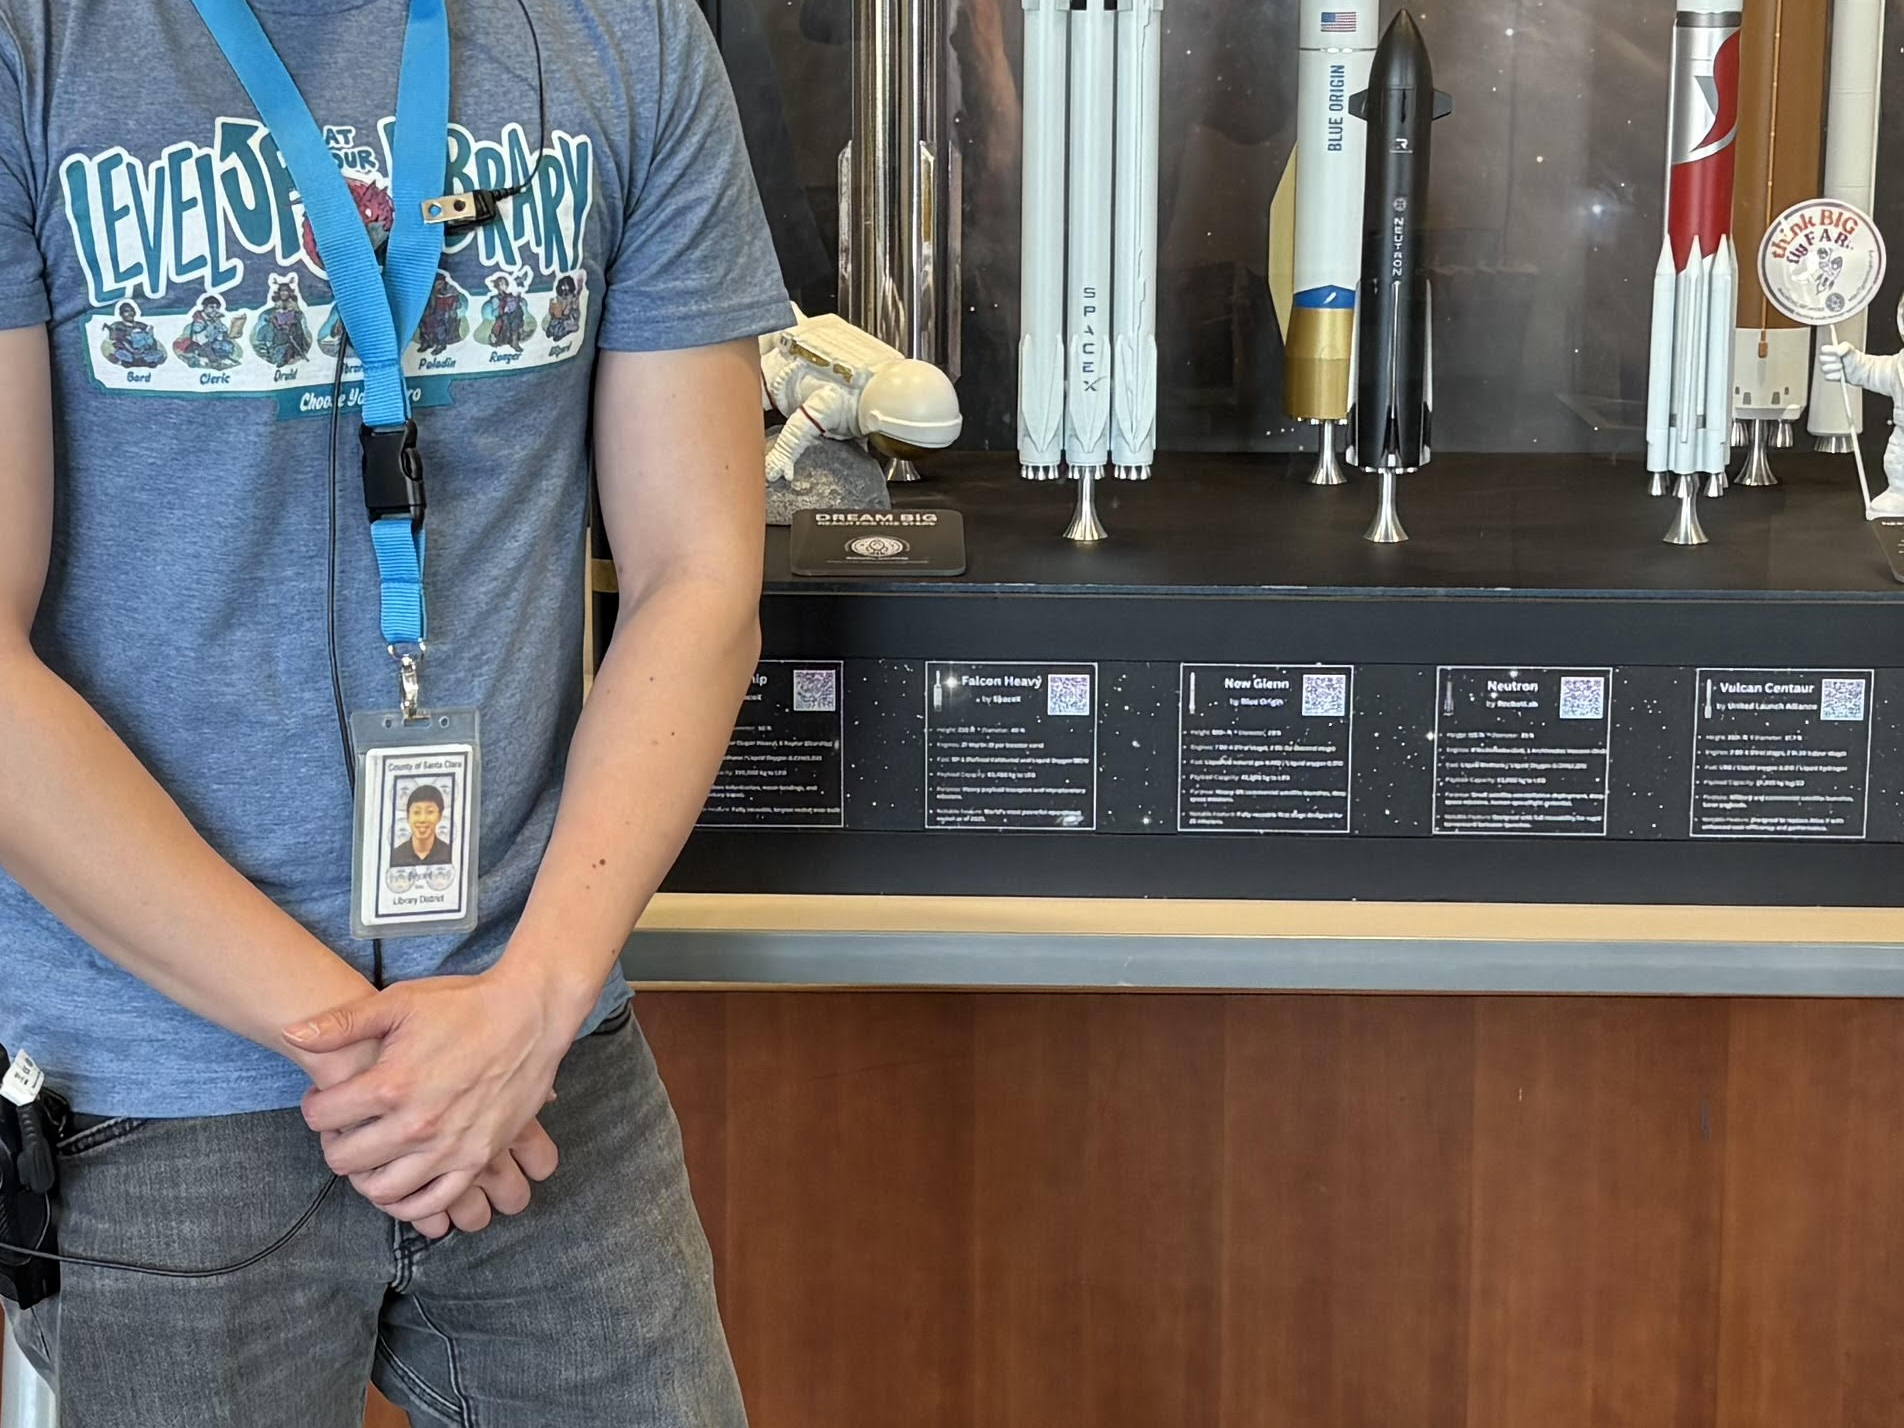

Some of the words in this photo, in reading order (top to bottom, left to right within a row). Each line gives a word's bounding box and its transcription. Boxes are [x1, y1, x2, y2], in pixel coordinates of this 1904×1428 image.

[1329, 64, 1345, 111] ORIGIN
[1327, 117, 1343, 152] BLUE
[65, 145, 241, 302] LEVEL
[1771, 213, 1816, 259] think
[1819, 209, 1858, 236] BIG
[1082, 287, 1104, 392] SPACEX
[199, 373, 231, 385] Cleric
[815, 513, 893, 522] DREAM
[900, 513, 938, 522] BIG
[962, 675, 1001, 687] Falcon
[1003, 675, 1042, 690] Heavy
[1224, 678, 1250, 690] New
[1253, 678, 1290, 690] Glenn
[1487, 680, 1538, 692] Neutron
[1720, 682, 1761, 694] Vulcan
[1764, 682, 1815, 694] Centaur
